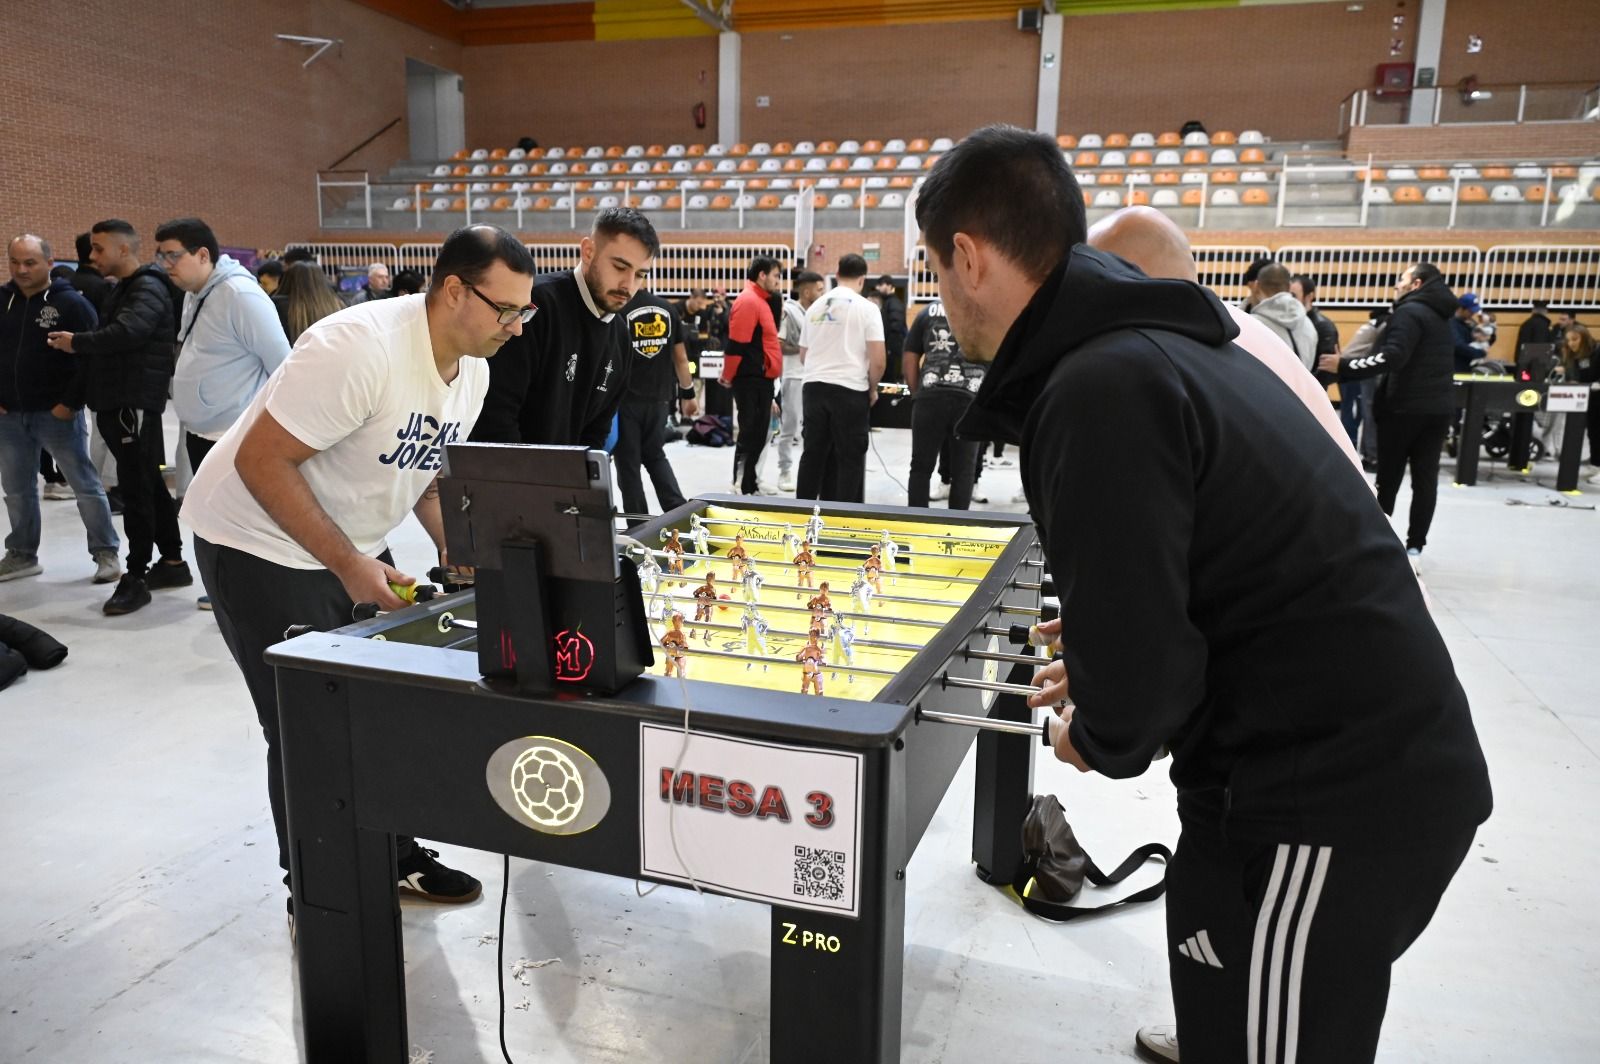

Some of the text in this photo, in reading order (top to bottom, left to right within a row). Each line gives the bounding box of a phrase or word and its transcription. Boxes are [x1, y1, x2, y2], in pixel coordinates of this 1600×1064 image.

[659, 766, 836, 829] MESA 3
[782, 922, 841, 953] Z PRO
